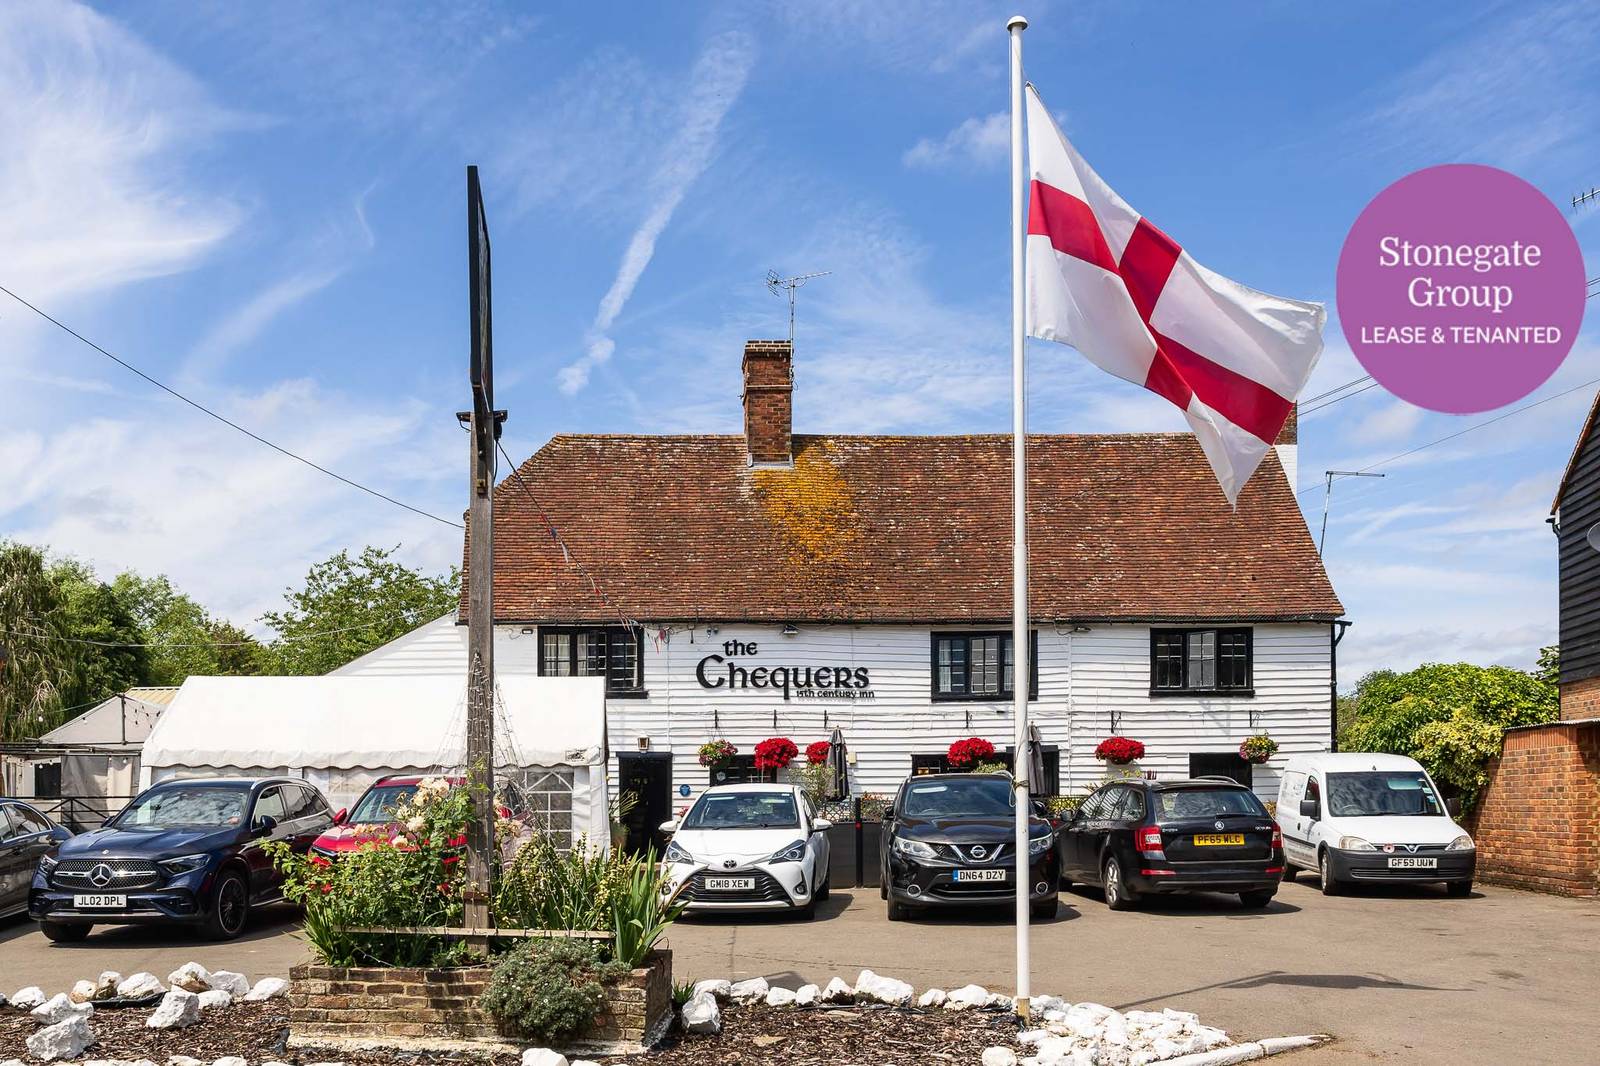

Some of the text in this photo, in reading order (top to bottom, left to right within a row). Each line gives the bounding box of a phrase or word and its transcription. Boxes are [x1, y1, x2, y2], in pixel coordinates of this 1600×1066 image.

[722, 639, 758, 656] the
[796, 689, 875, 699] 15th century inn
[1198, 835, 1221, 844] PF65
[1391, 858, 1415, 867] GF59
[959, 870, 1004, 880] DN64 DZY
[710, 879, 749, 888] GM18 XEW
[78, 896, 123, 906] JL02 DPL
